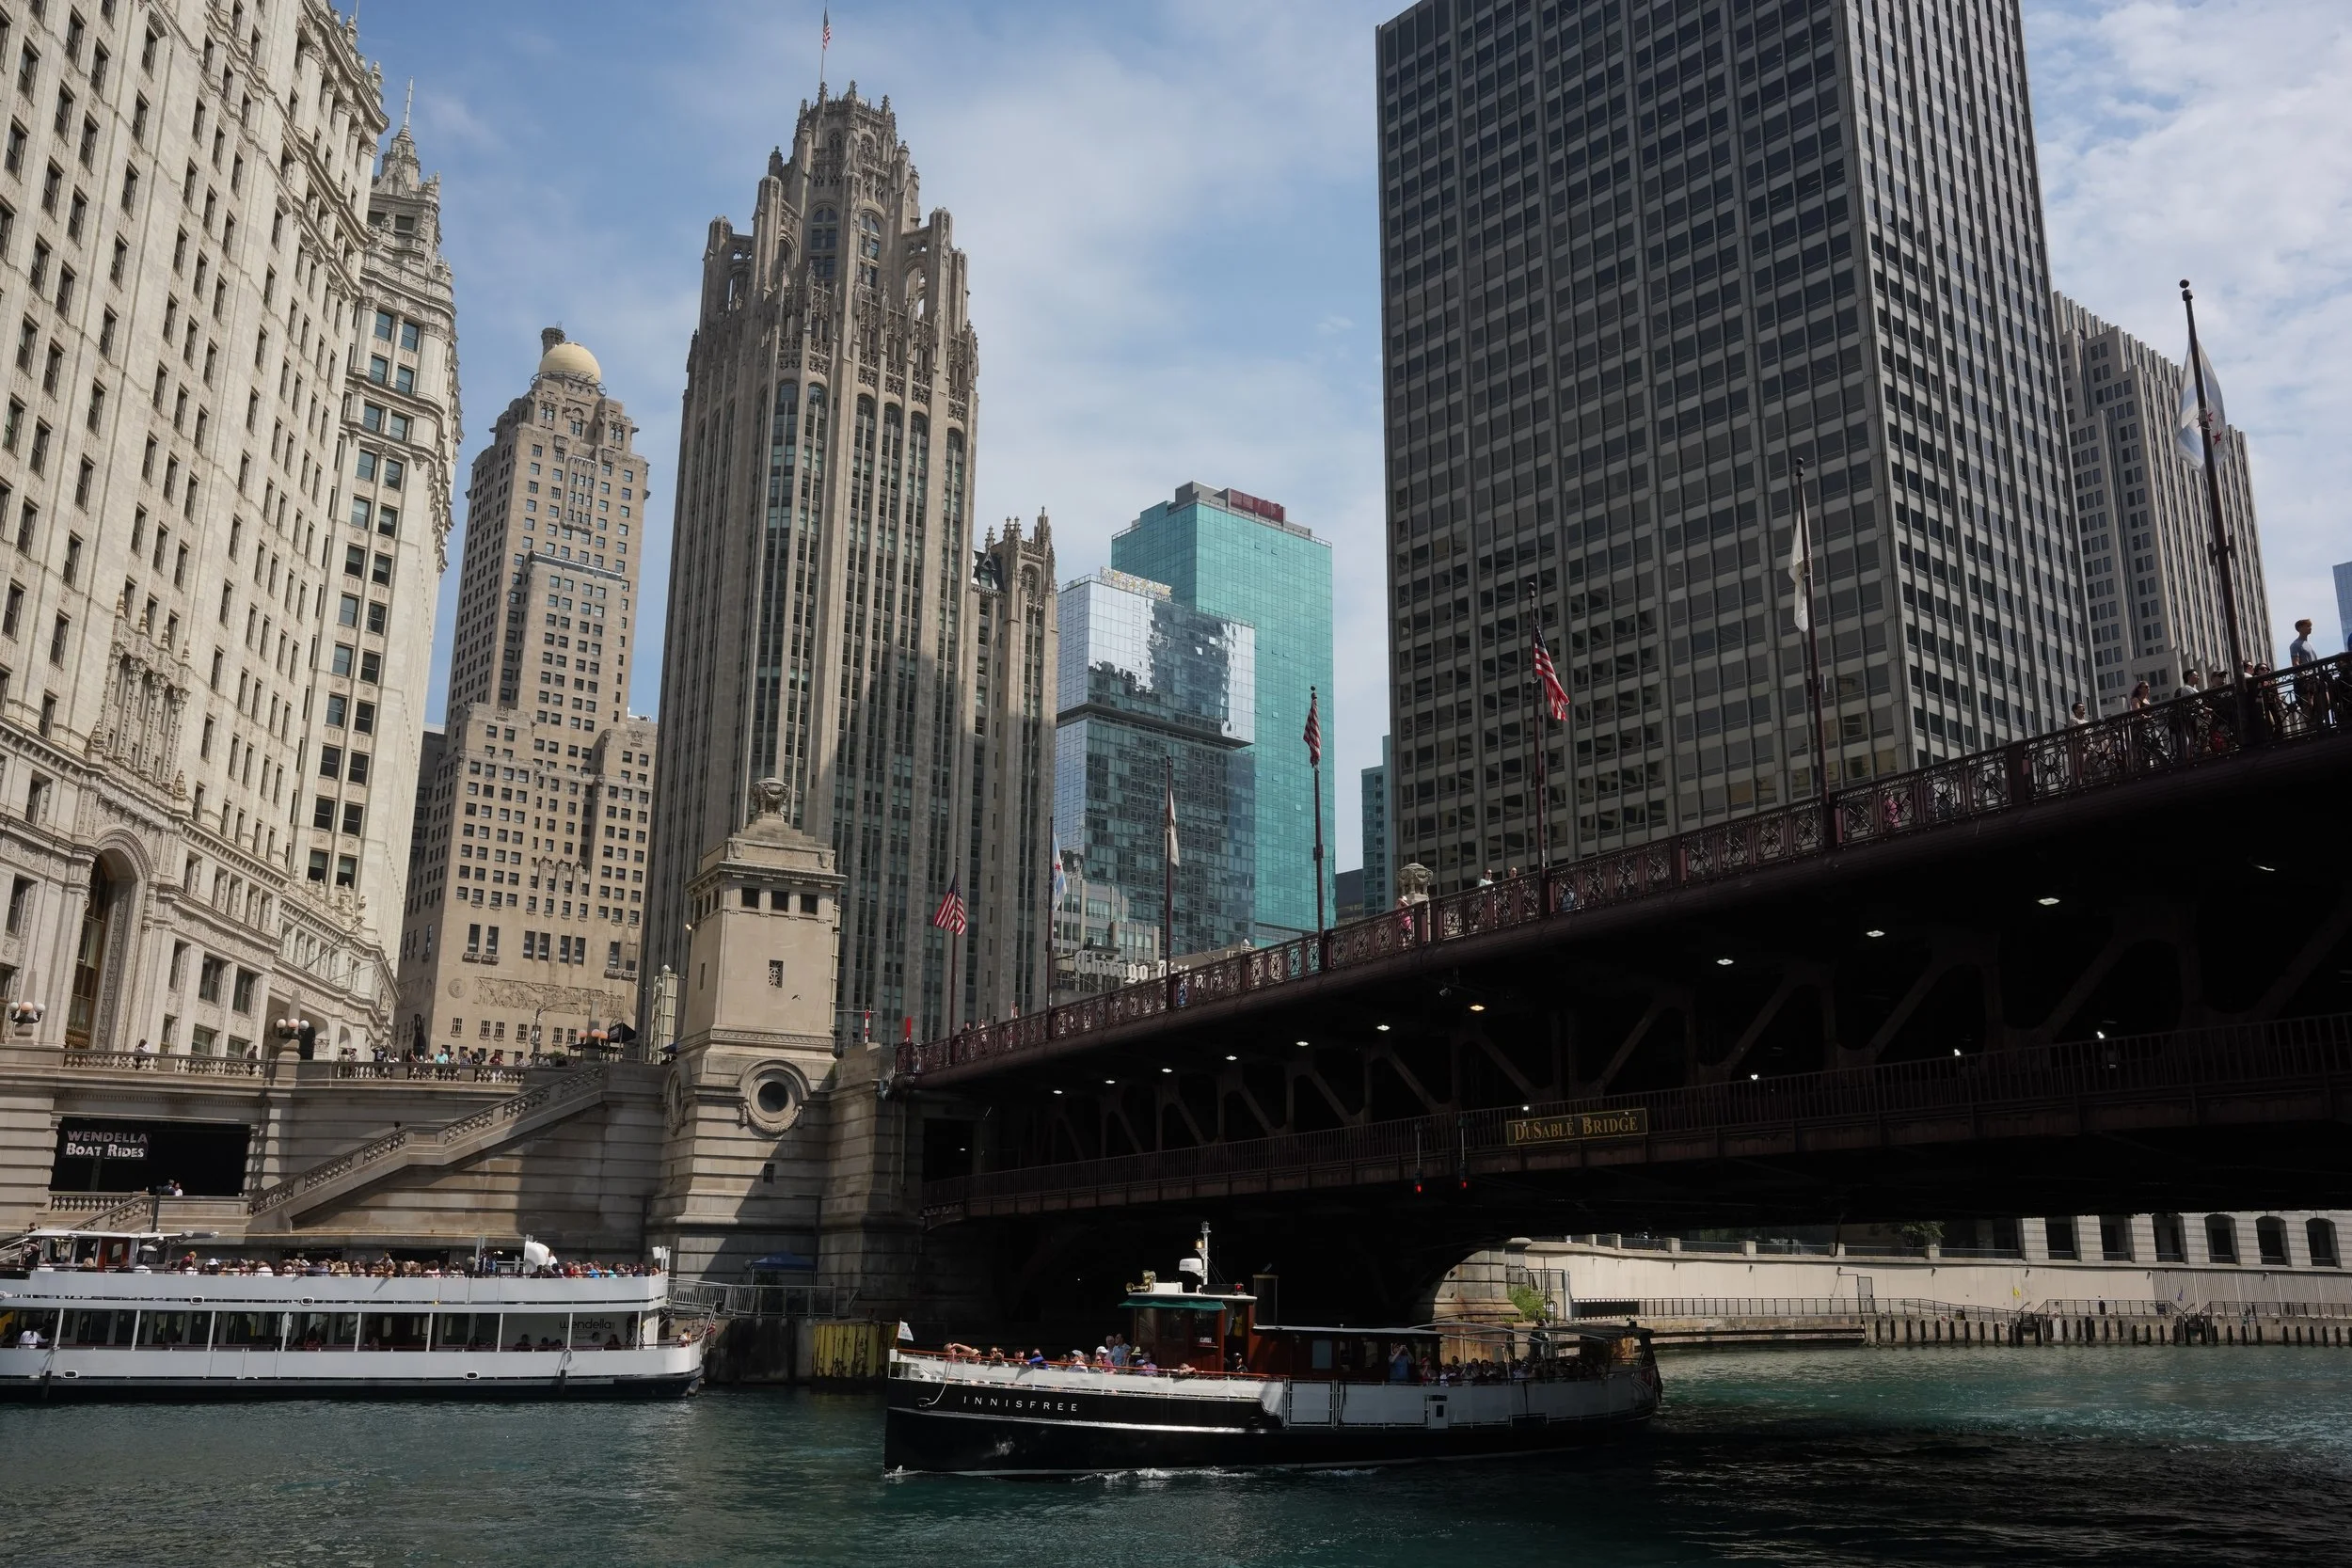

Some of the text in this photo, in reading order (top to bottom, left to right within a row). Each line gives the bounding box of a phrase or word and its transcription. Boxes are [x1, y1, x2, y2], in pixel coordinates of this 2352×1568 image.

[1073, 949, 1149, 984] Chicago
[67, 1130, 149, 1144] WENDELLA
[963, 1395, 1078, 1412] INNISFREE
